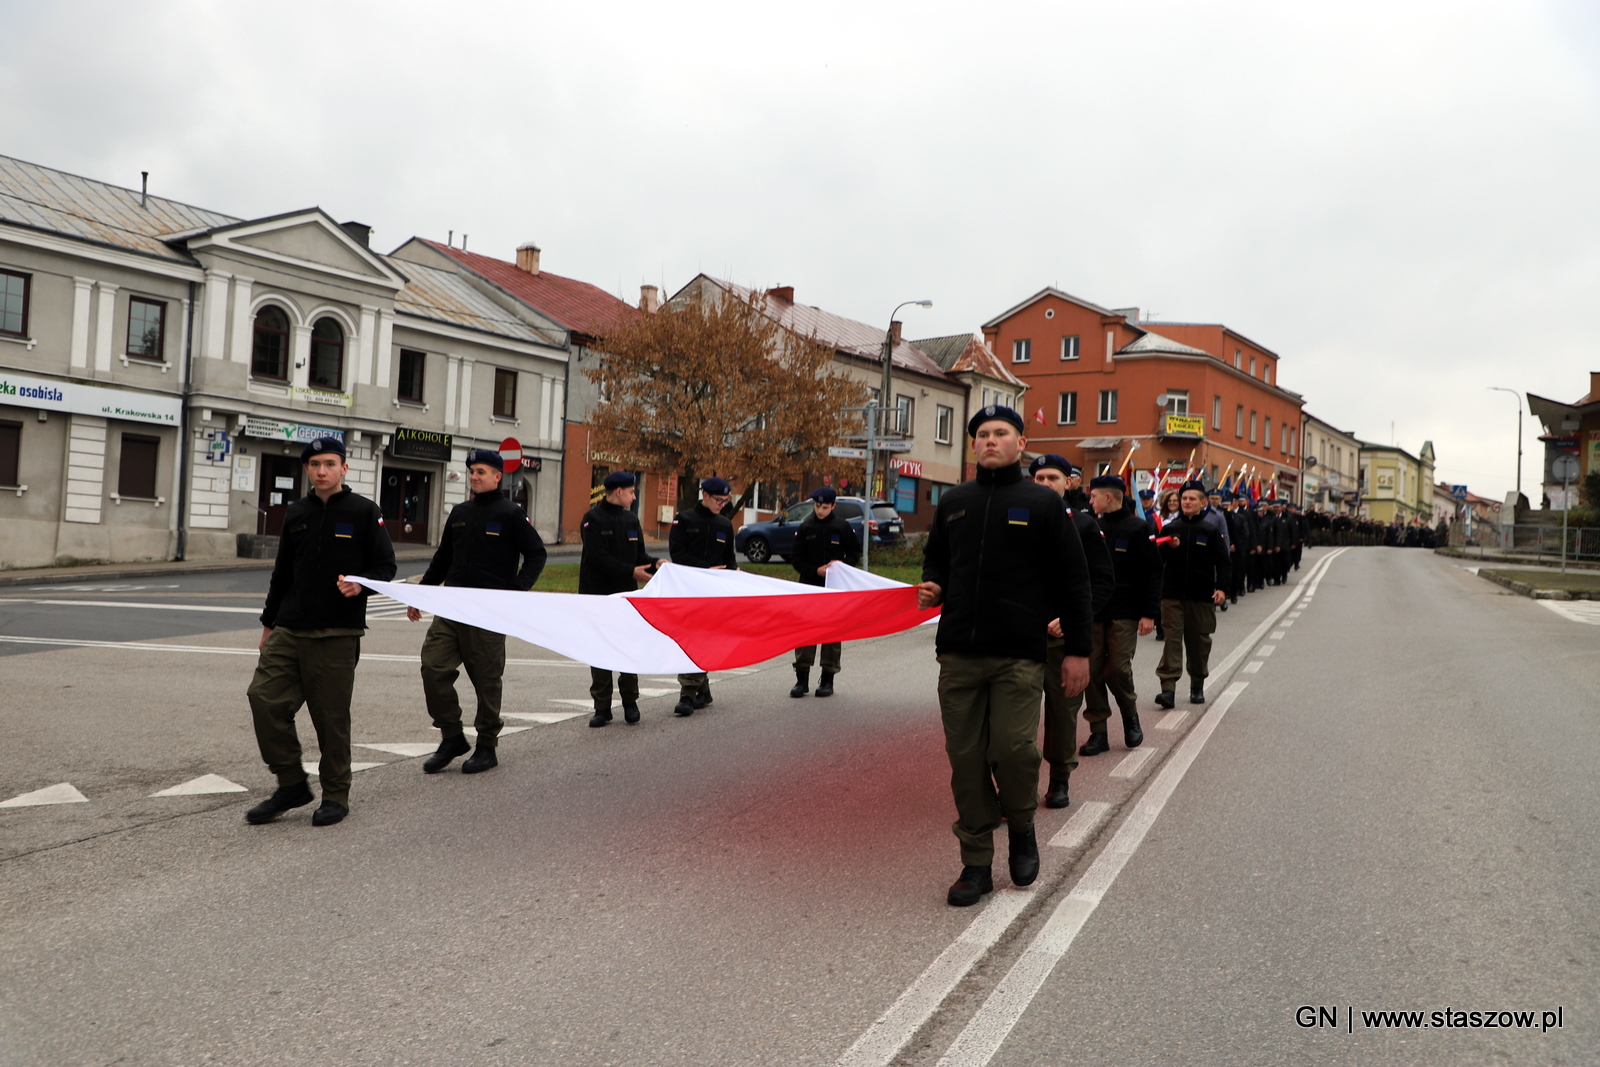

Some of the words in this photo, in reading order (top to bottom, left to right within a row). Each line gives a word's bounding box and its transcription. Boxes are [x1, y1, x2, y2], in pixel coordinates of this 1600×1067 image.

[19, 385, 63, 402] osobista
[101, 406, 112, 414] ul.
[115, 407, 162, 420] Krakowska
[164, 413, 174, 422] 14
[397, 429, 450, 447] ALKOHOLE
[890, 458, 922, 476] OPTYK
